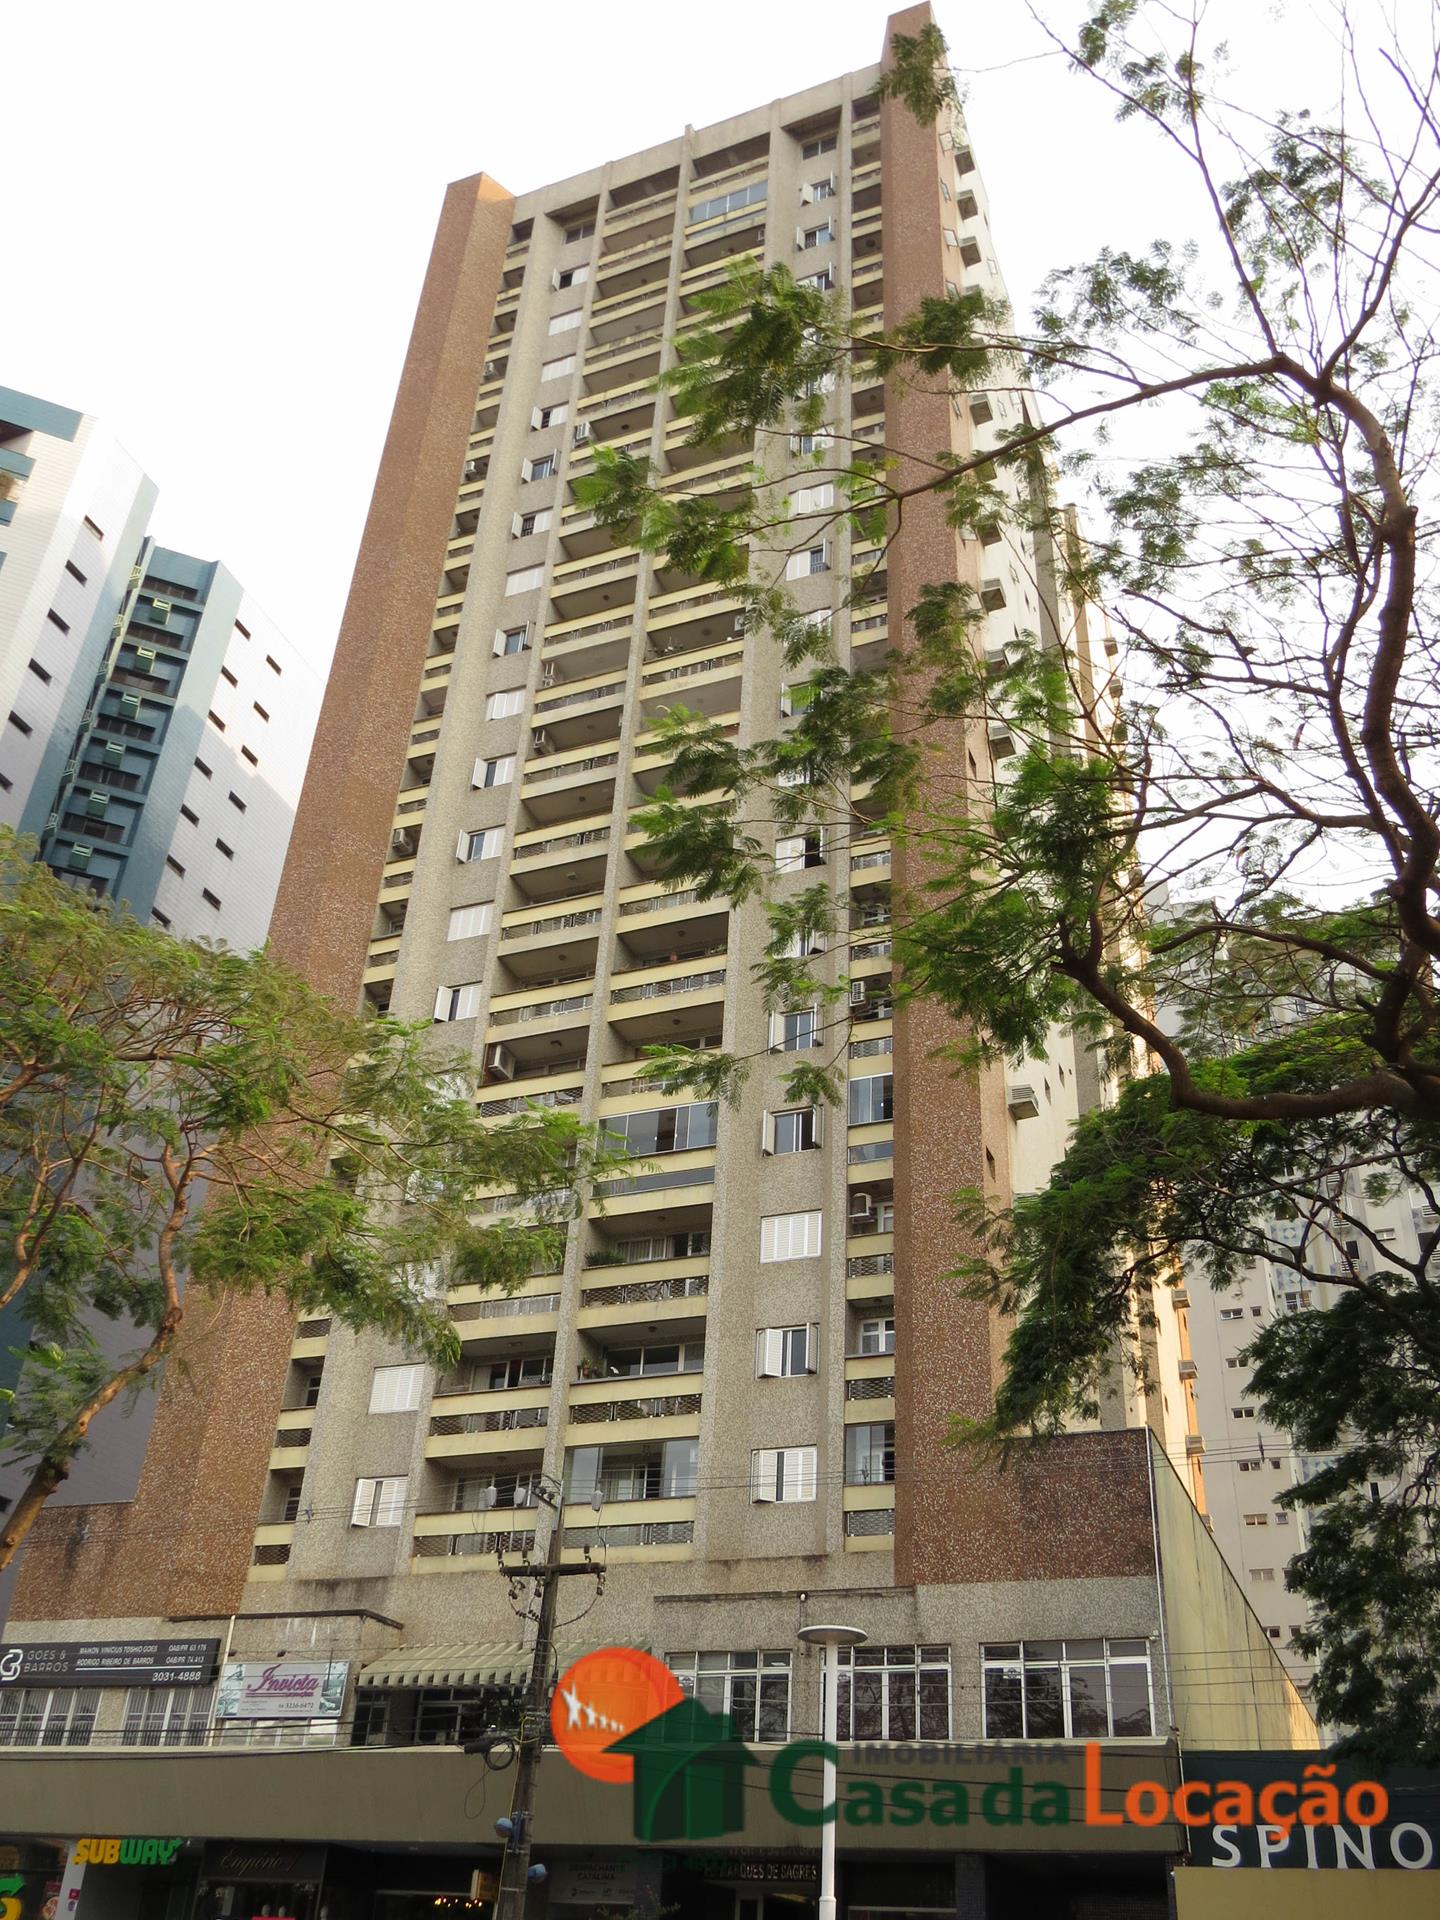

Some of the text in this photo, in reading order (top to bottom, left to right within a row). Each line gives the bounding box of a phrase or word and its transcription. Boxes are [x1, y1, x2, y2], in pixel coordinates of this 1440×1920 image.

[59, 1649, 67, 1659] &
[23, 1662, 69, 1673] BARROS
[76, 1658, 100, 1666] RODRIGO
[101, 1657, 122, 1665] RIBEIRO
[123, 1657, 132, 1665] DE
[132, 1657, 154, 1665] BARROS
[152, 1671, 202, 1682] 3031-4888
[247, 1663, 320, 1692] Invicta
[72, 1838, 184, 1866] SUBWAY
[1211, 1822, 1434, 1870] SPINO
[767, 1864, 778, 1880] DE
[780, 1864, 817, 1881] SAGRES
